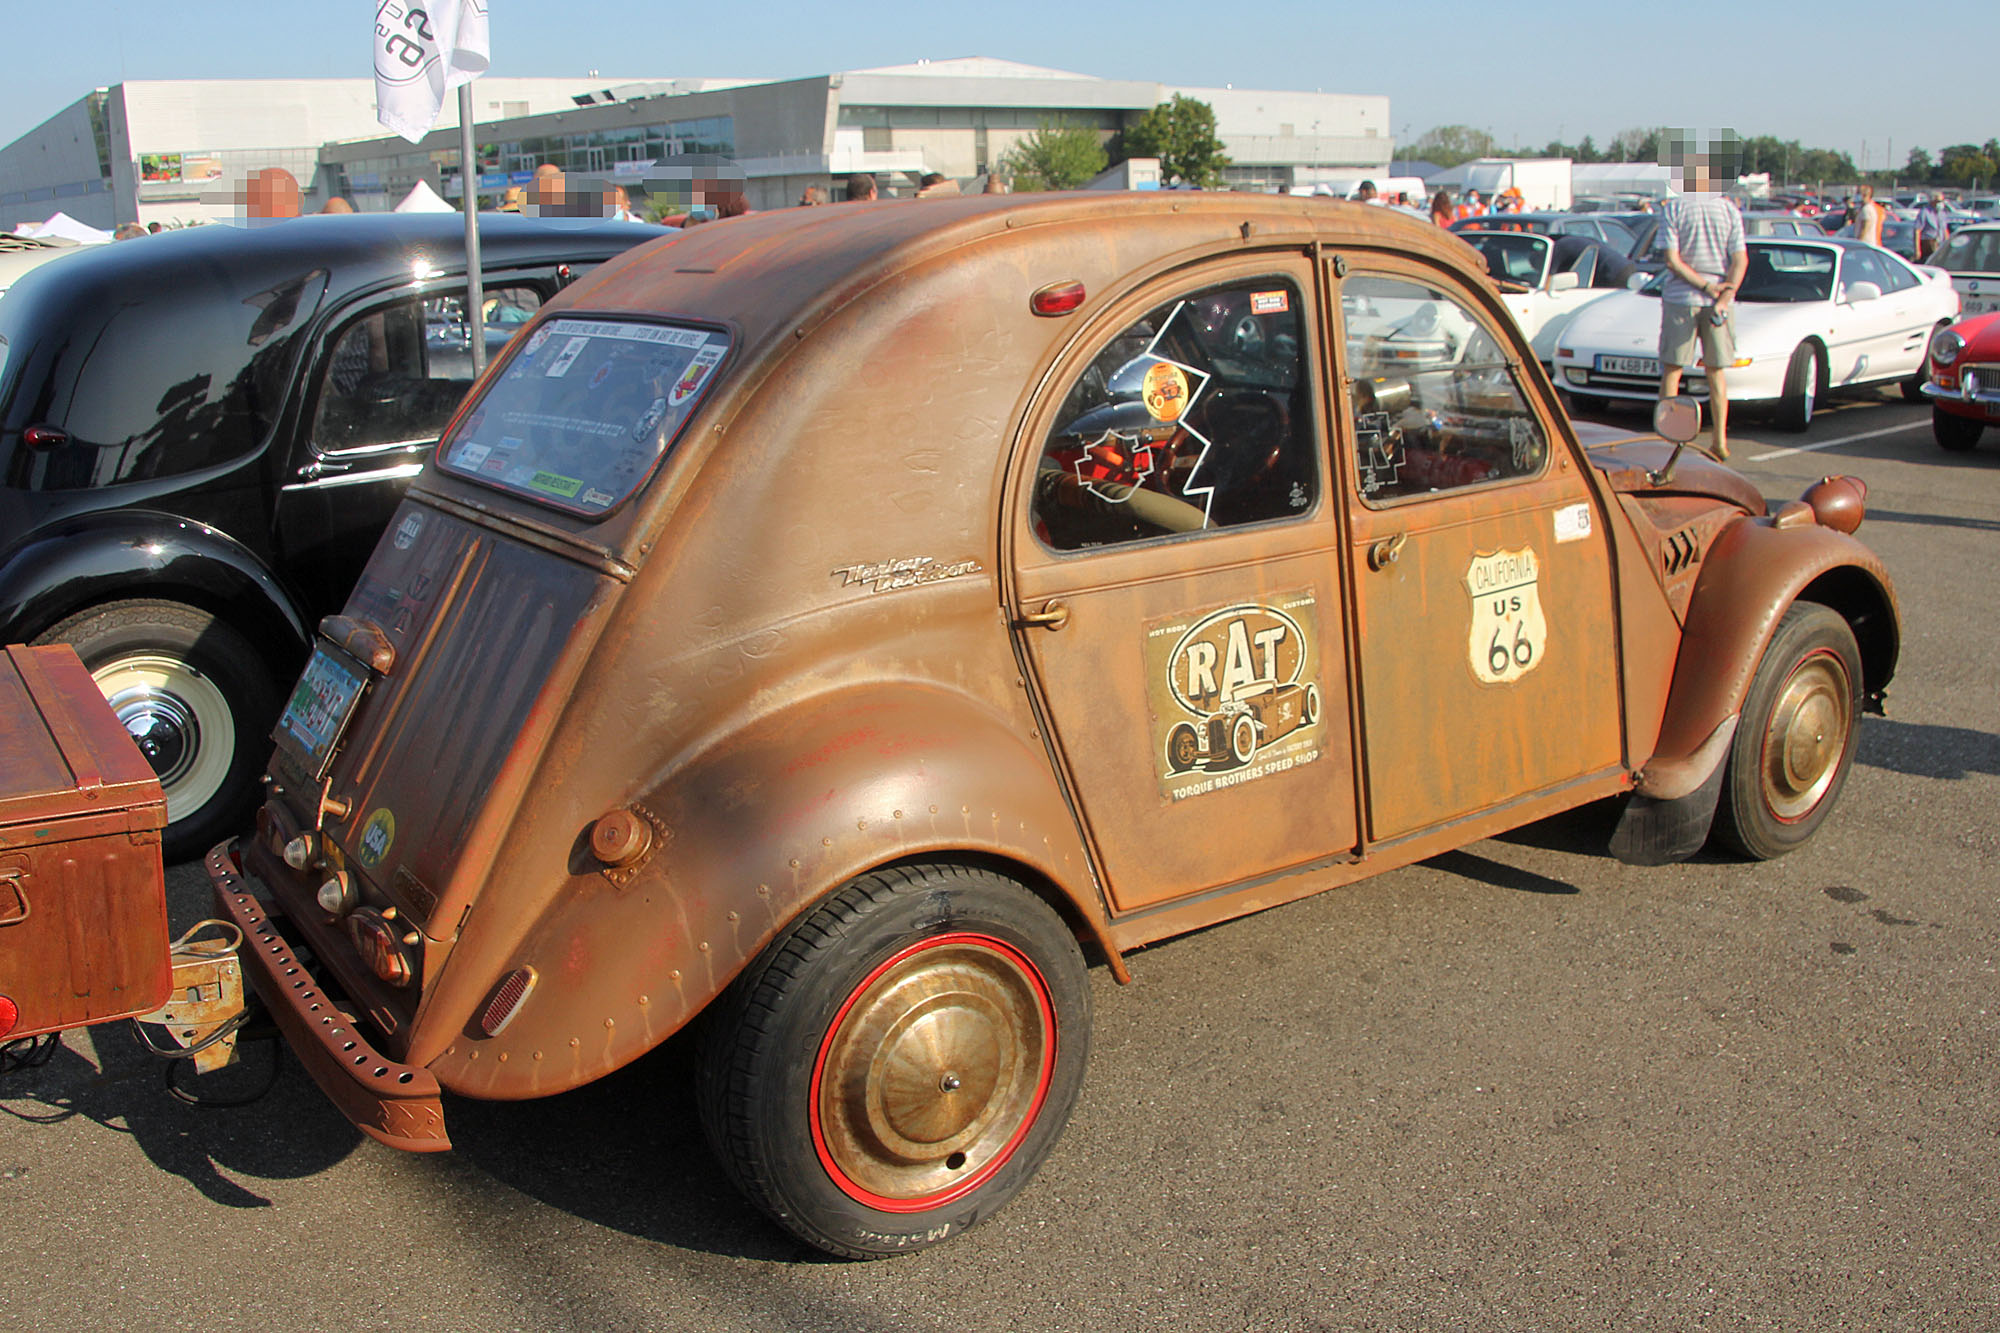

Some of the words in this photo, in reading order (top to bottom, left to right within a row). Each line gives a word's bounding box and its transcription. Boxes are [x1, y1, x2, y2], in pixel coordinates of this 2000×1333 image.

[1475, 554, 1532, 591] CALIFORNIA
[1283, 597, 1316, 610] CUSTOMS
[1492, 596, 1522, 617] US
[1148, 626, 1165, 639] HOT
[1166, 624, 1187, 635] RODS
[1488, 620, 1533, 676] 66
[1186, 618, 1287, 703] RAT
[1172, 778, 1214, 800] TORQUE
[1215, 766, 1264, 790] BROTHERS
[1264, 757, 1294, 776] SPEED
[1294, 749, 1319, 767] SHOP
[364, 823, 388, 857] USA
